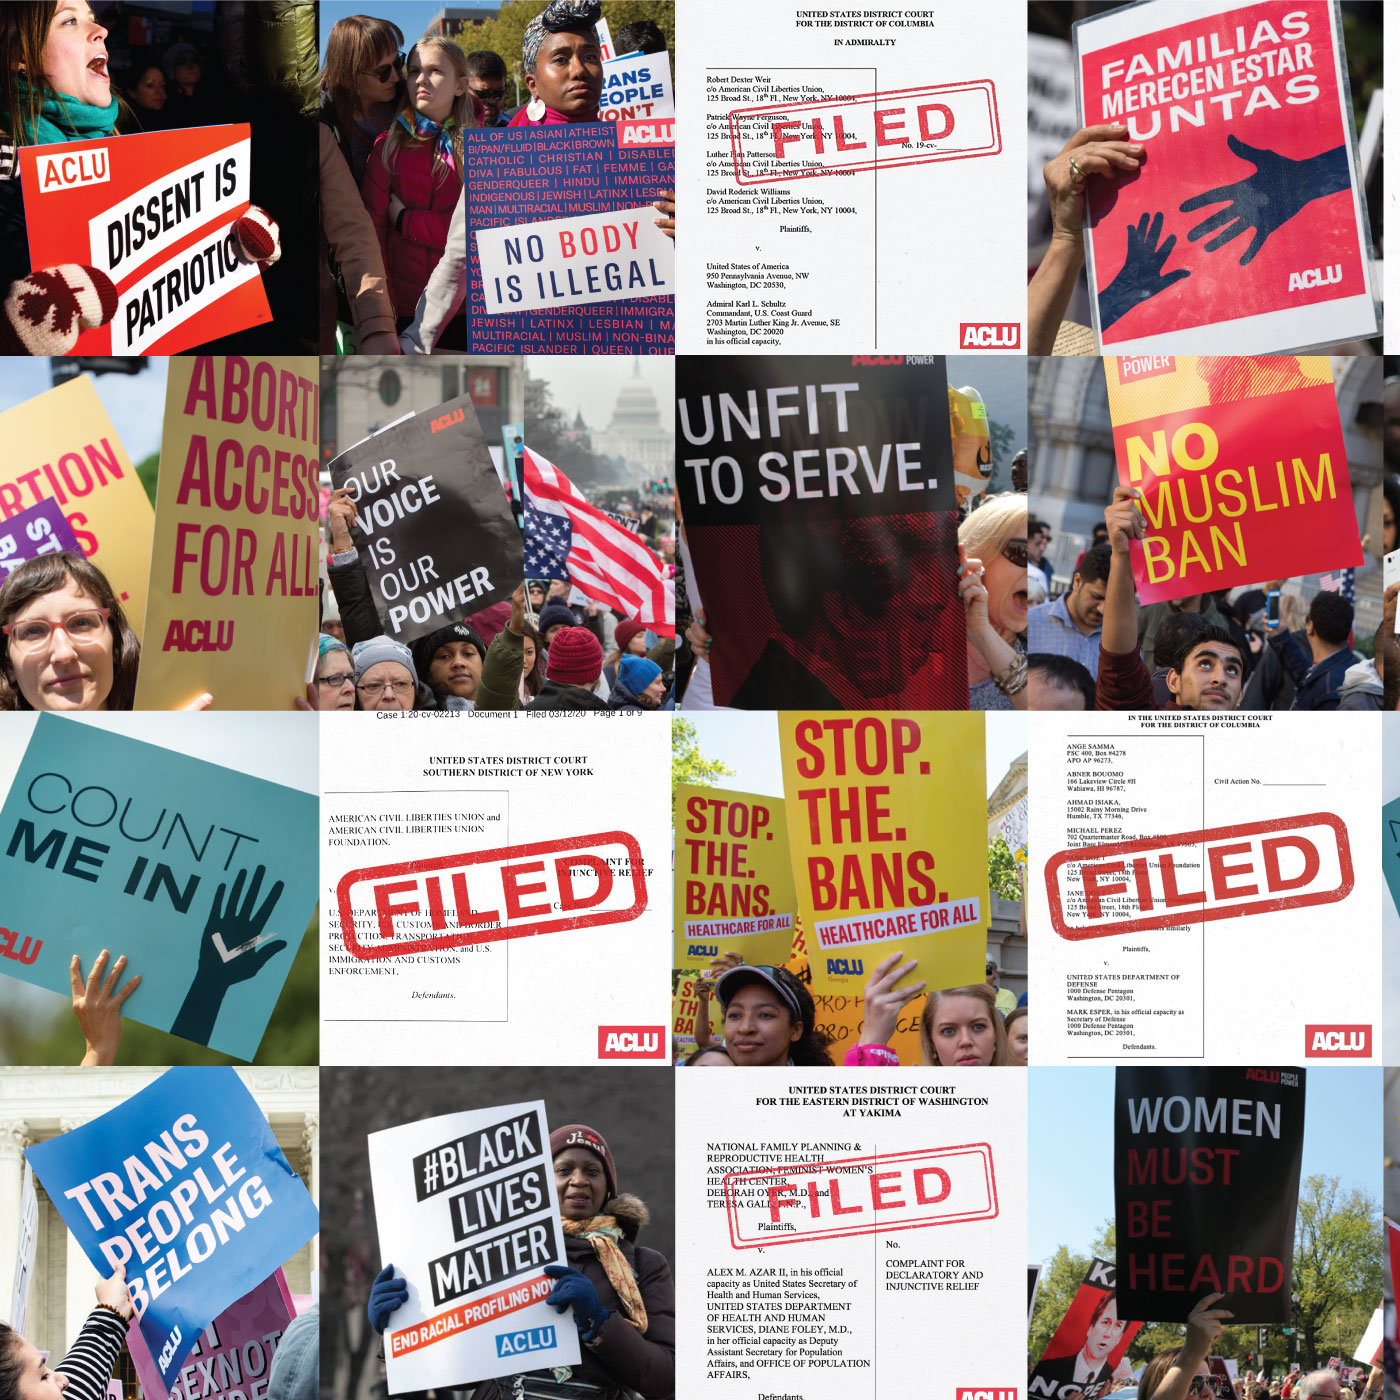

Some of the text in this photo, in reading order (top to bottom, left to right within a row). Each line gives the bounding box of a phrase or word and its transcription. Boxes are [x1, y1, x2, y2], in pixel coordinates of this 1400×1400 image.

[834, 38, 897, 46] IN ADMIRALTY
[1102, 11, 1310, 88] FAMILIAS
[1102, 44, 1314, 119] MERECEN ESTAR
[1110, 75, 1319, 141] UNTAS
[528, 126, 616, 139] ASIAN ATHEIST
[623, 123, 674, 144] ACLU
[772, 103, 955, 159] FILED
[44, 152, 105, 188] ACLU
[108, 158, 236, 270] DISSENT IS
[504, 221, 639, 266] NO BODY
[127, 233, 239, 347] PATRIOTIC
[494, 258, 665, 304] IS ILLEGAL
[1288, 264, 1342, 292] ACLU
[963, 327, 1016, 346] ACLU
[1122, 356, 1171, 377] POWER
[431, 408, 465, 433] ACLU
[680, 383, 859, 445] UNFIT
[685, 443, 938, 505] TO SERVE.
[1126, 423, 1219, 480] NO
[176, 435, 319, 521] ACCESS
[343, 458, 402, 502] OUR
[1135, 453, 1337, 530] MUSLIM
[355, 475, 441, 535] VOICE
[172, 523, 257, 596] FOR
[367, 537, 396, 570] IS
[1142, 522, 1248, 584] BAN
[379, 555, 440, 600] OUR
[389, 567, 495, 633] POWER
[163, 619, 234, 652] ACLU
[429, 756, 586, 765] UNITED STATES DISTRICT COURT
[795, 718, 931, 779] STOP.
[28, 772, 259, 871] COUNT
[685, 797, 774, 841] STOP.
[798, 786, 907, 846] THE.
[5, 818, 201, 914] ME IN
[685, 840, 755, 879] THE.
[807, 851, 949, 911] BANS.
[1082, 835, 1321, 919] FILED
[373, 854, 613, 938] FILED
[685, 880, 775, 918] BANS.
[0, 926, 43, 965] CLU
[688, 916, 790, 937] HEALTHCARE FOR ALL
[820, 903, 977, 946] HEALTHCARE FOR ALL
[687, 945, 718, 957] ACLU
[826, 958, 864, 976] ACLU
[605, 1033, 659, 1053] ACLU
[1311, 1031, 1366, 1052] ACLU
[1245, 1068, 1279, 1083] ACLU
[842, 1108, 902, 1117] AT YAKIMA
[1128, 1096, 1281, 1139] WOMEN
[64, 1113, 210, 1231] TRANS
[423, 1117, 536, 1194] #BLACK
[1128, 1148, 1239, 1186] MUST
[98, 1142, 246, 1271] PEOPLE
[458, 1171, 542, 1234] LIVES
[767, 1167, 952, 1223] FILED
[1128, 1201, 1171, 1238] BE
[128, 1176, 273, 1323] BELONG
[435, 1225, 550, 1299] MATTER
[1128, 1253, 1284, 1293] HEARD
[157, 1325, 182, 1376] ACLU
[500, 1329, 553, 1354] ACLU
